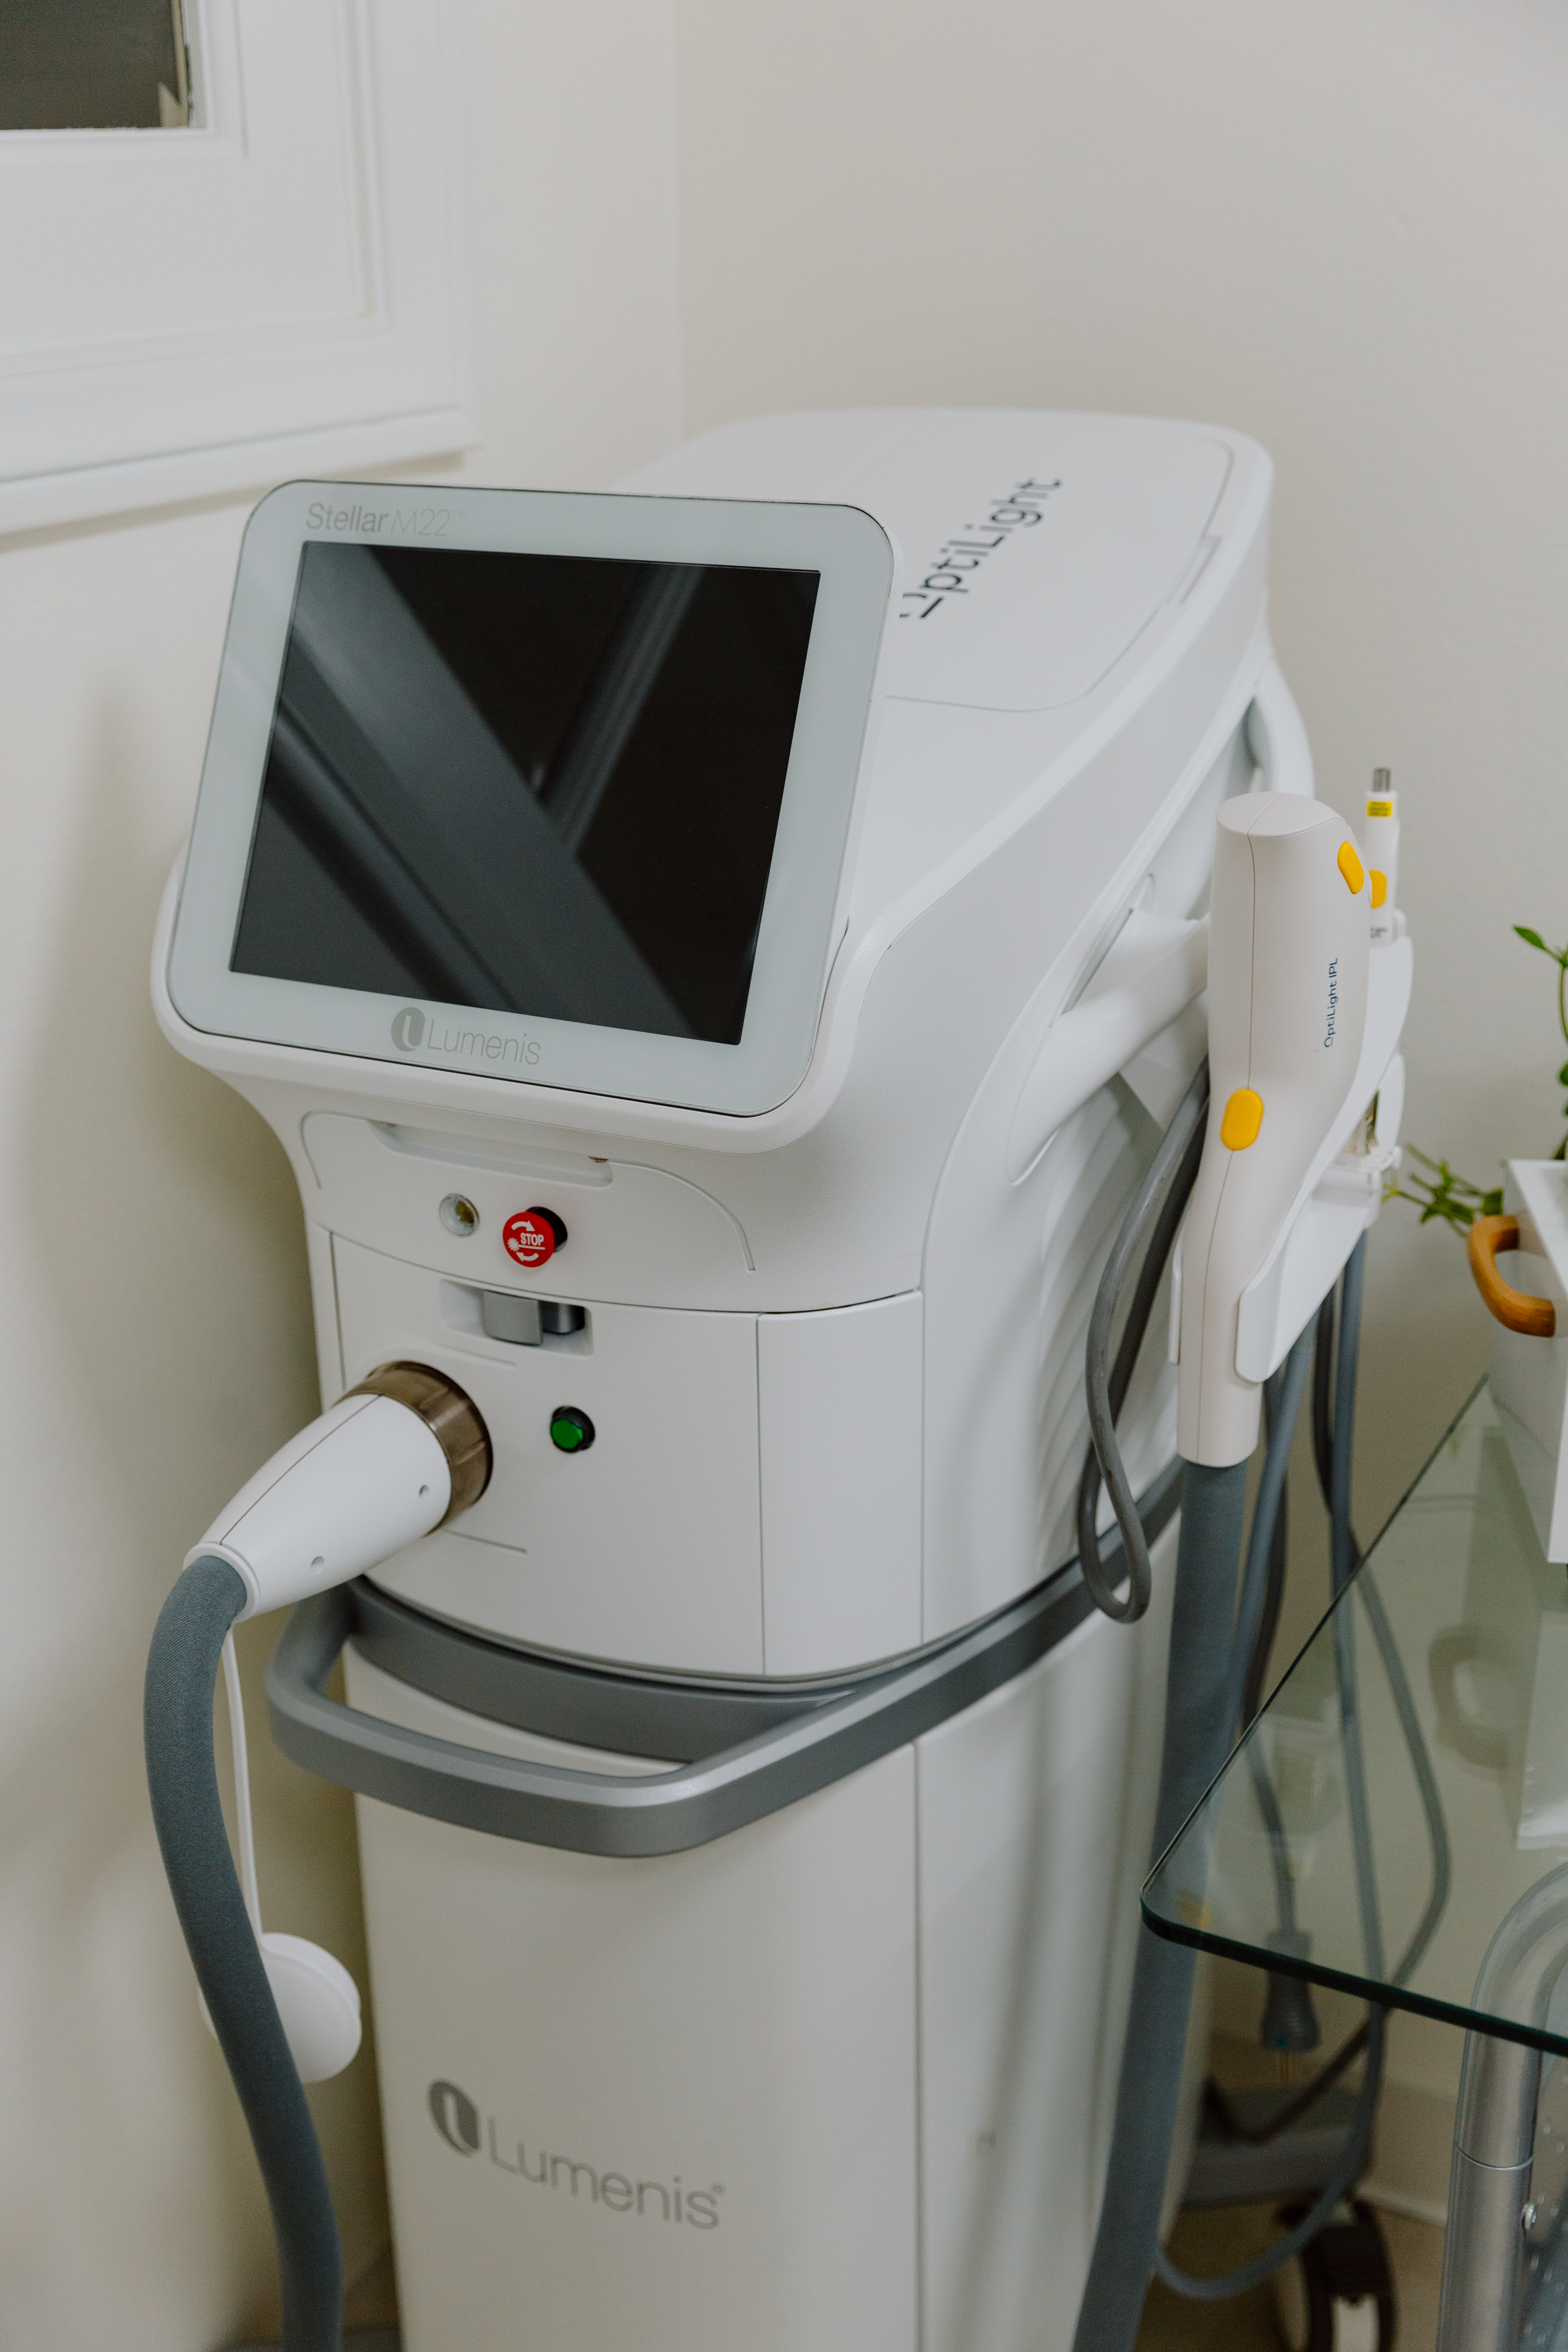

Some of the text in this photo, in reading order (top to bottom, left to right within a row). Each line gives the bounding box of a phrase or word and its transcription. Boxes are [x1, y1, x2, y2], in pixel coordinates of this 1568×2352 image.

[306, 502, 388, 533] Stellar
[1324, 958, 1339, 1047] OptiLight IPL
[428, 1019, 541, 1065] Lumenis
[520, 1232, 544, 1246] STOP
